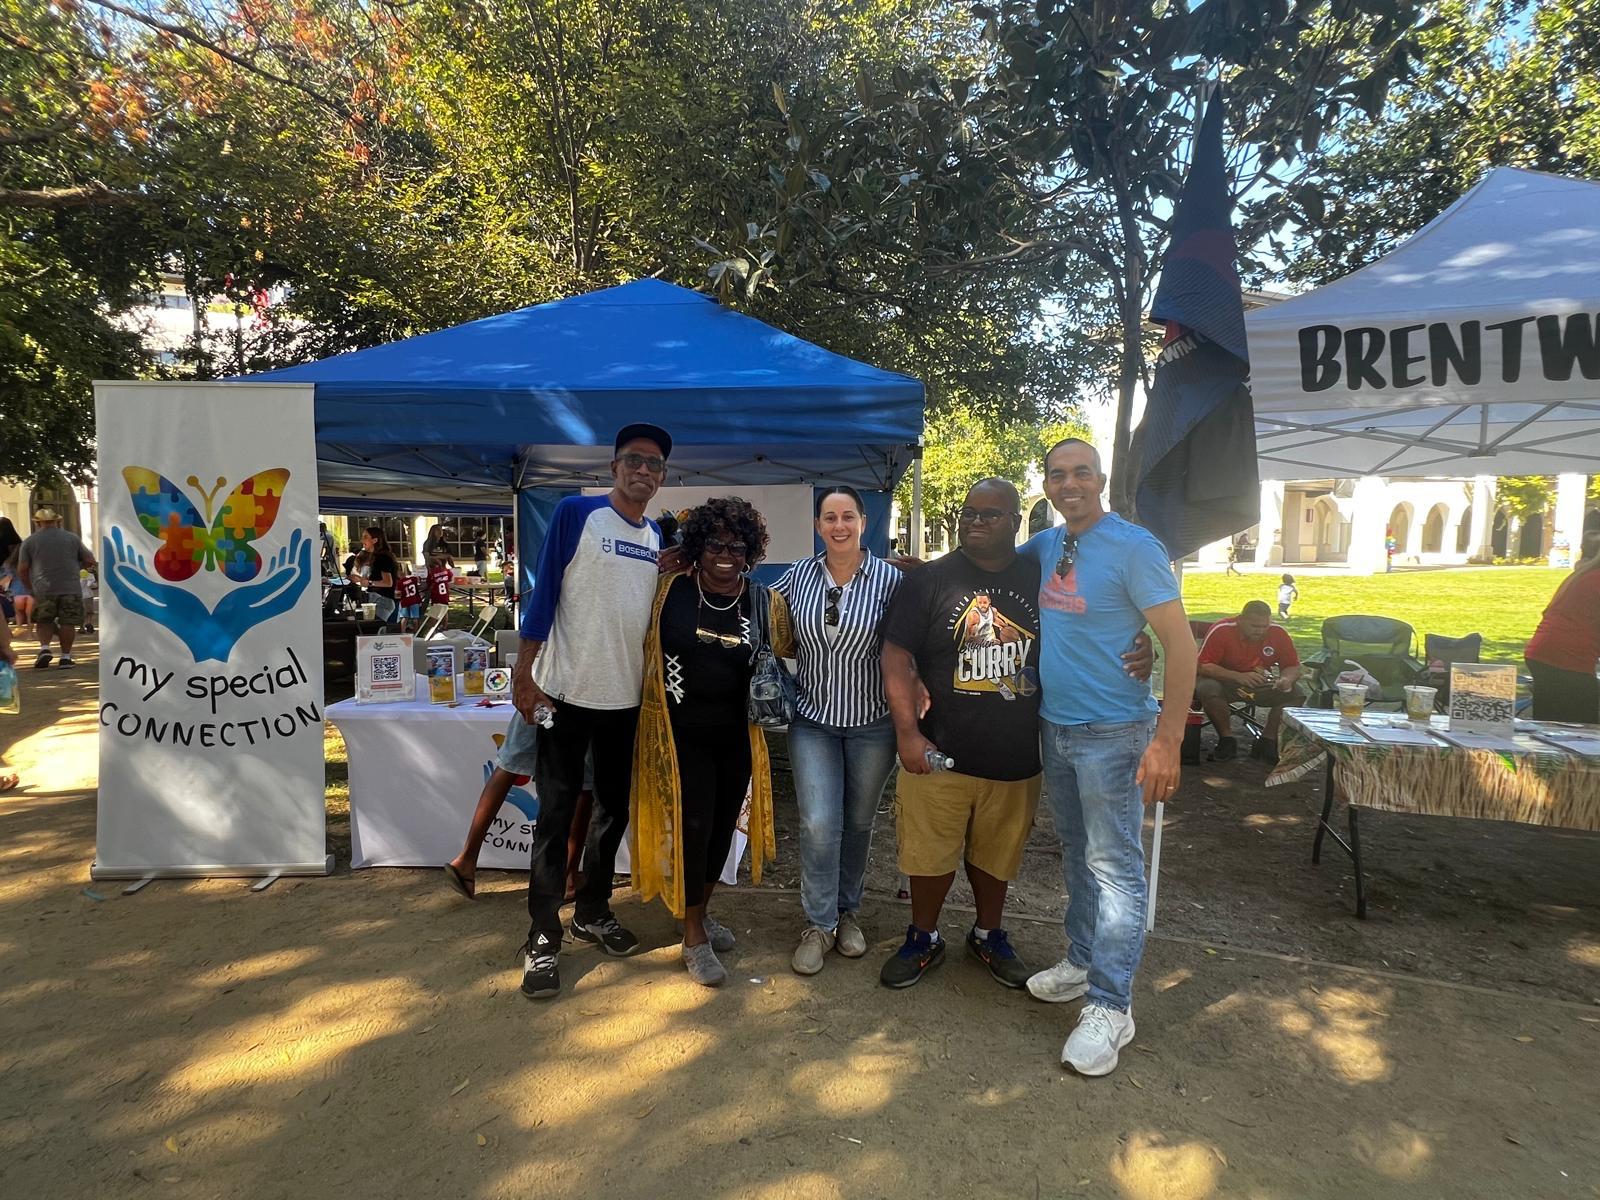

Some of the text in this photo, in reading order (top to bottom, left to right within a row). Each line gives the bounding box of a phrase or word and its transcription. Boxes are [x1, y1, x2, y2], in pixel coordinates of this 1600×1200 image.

[405, 584, 416, 597] 13
[438, 583, 447, 595] 8
[113, 647, 307, 714] my special
[958, 639, 1032, 682] CURRY
[100, 701, 321, 747] CONNECTION
